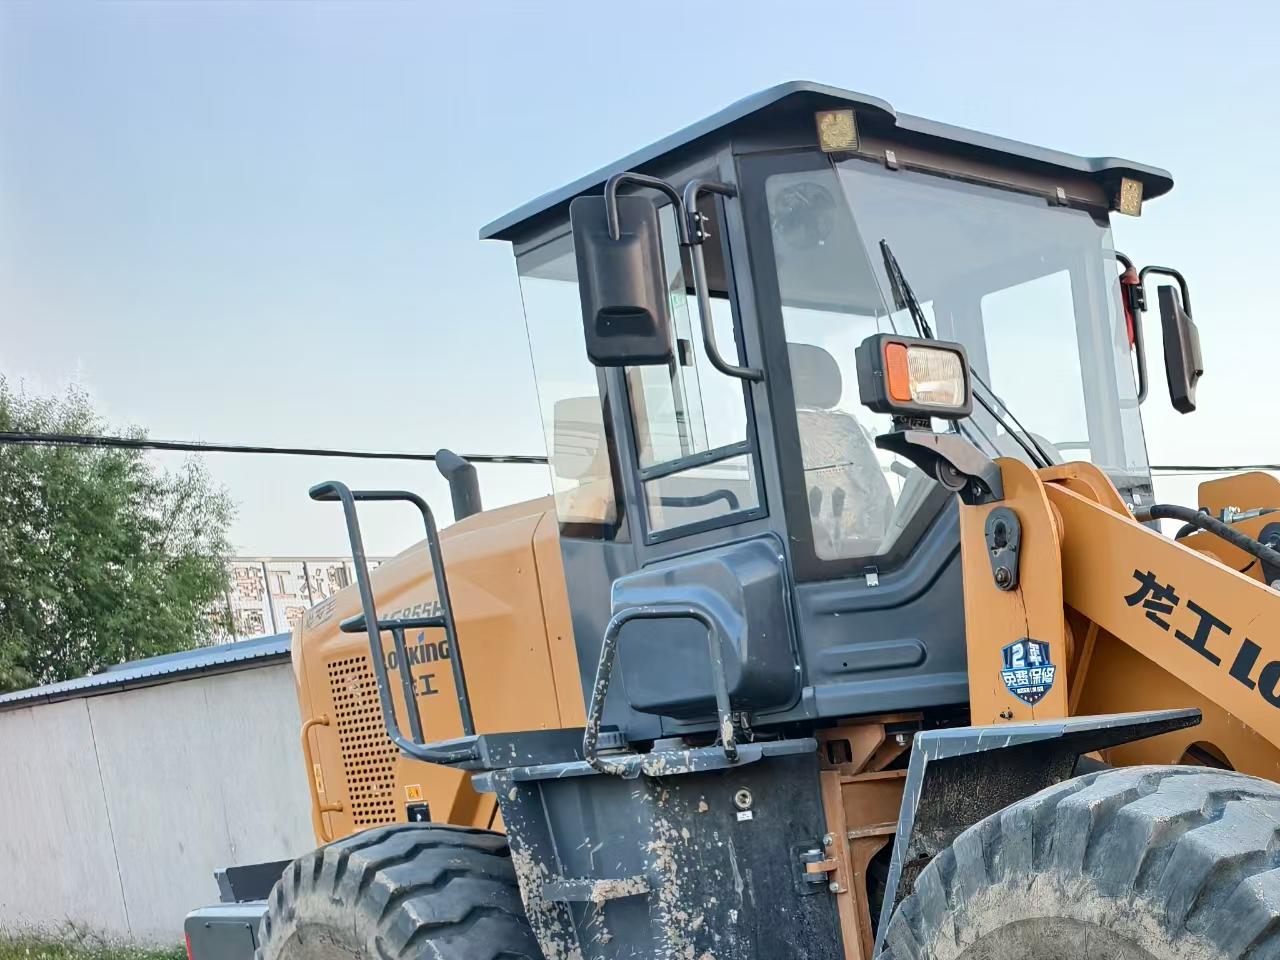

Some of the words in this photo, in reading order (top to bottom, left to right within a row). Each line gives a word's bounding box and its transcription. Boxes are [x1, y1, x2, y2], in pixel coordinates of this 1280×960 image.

[414, 673, 439, 697] 工
[1002, 667, 1055, 687] 免费保修
